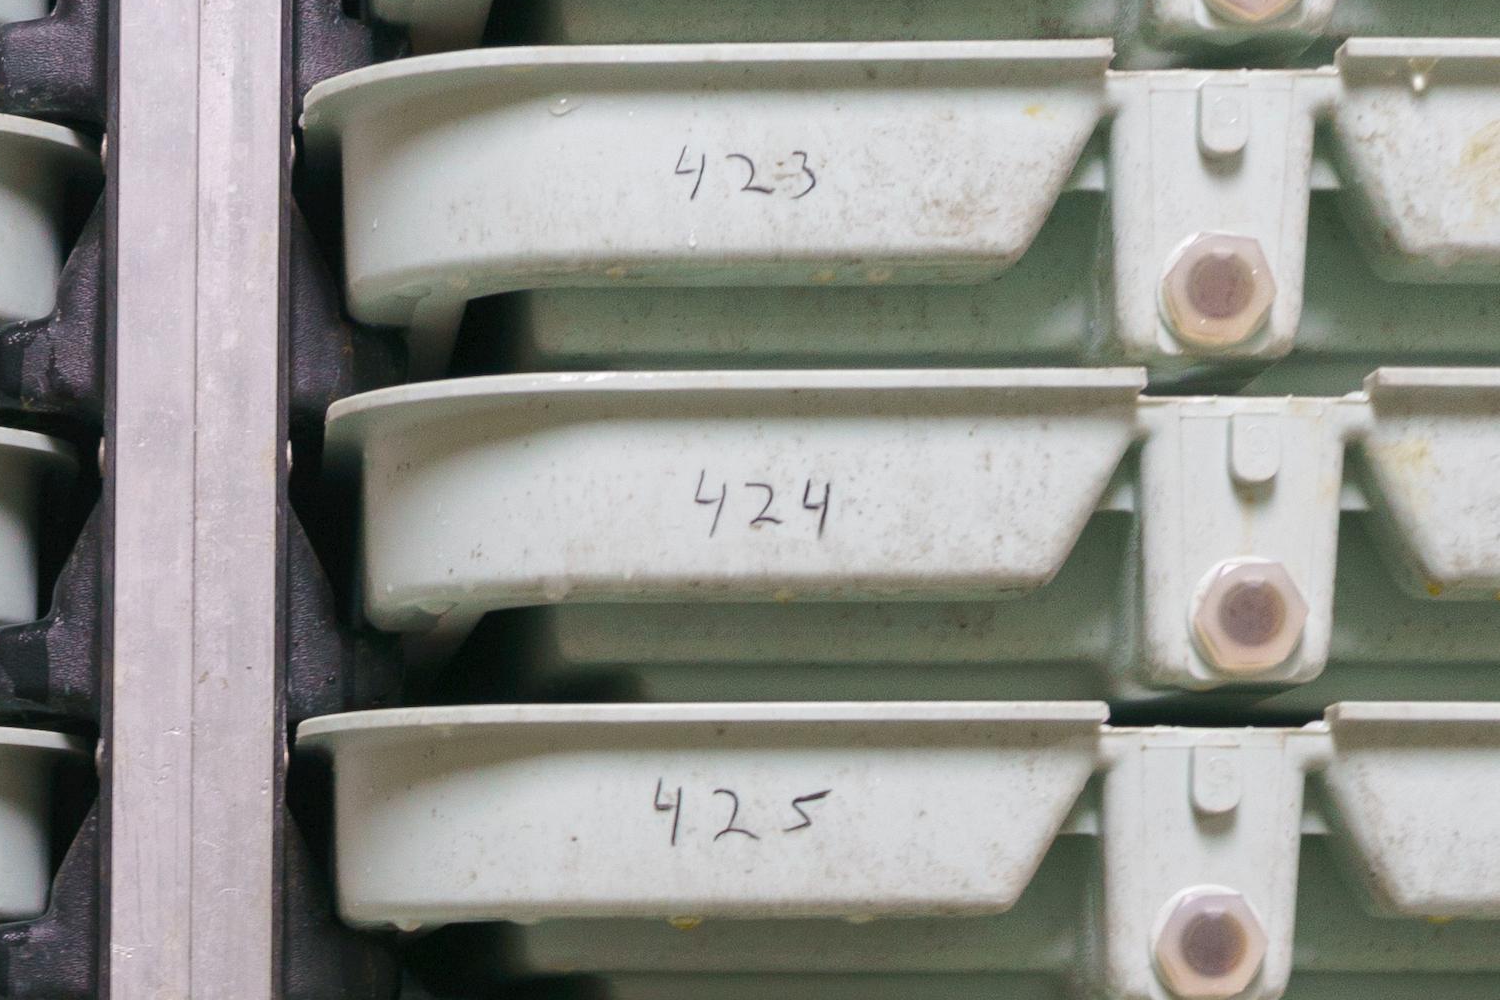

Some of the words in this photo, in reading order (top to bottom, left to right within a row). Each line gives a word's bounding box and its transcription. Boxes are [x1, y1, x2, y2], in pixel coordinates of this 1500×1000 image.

[674, 145, 817, 201] 423
[694, 469, 832, 538] 424
[653, 779, 830, 847] 425
